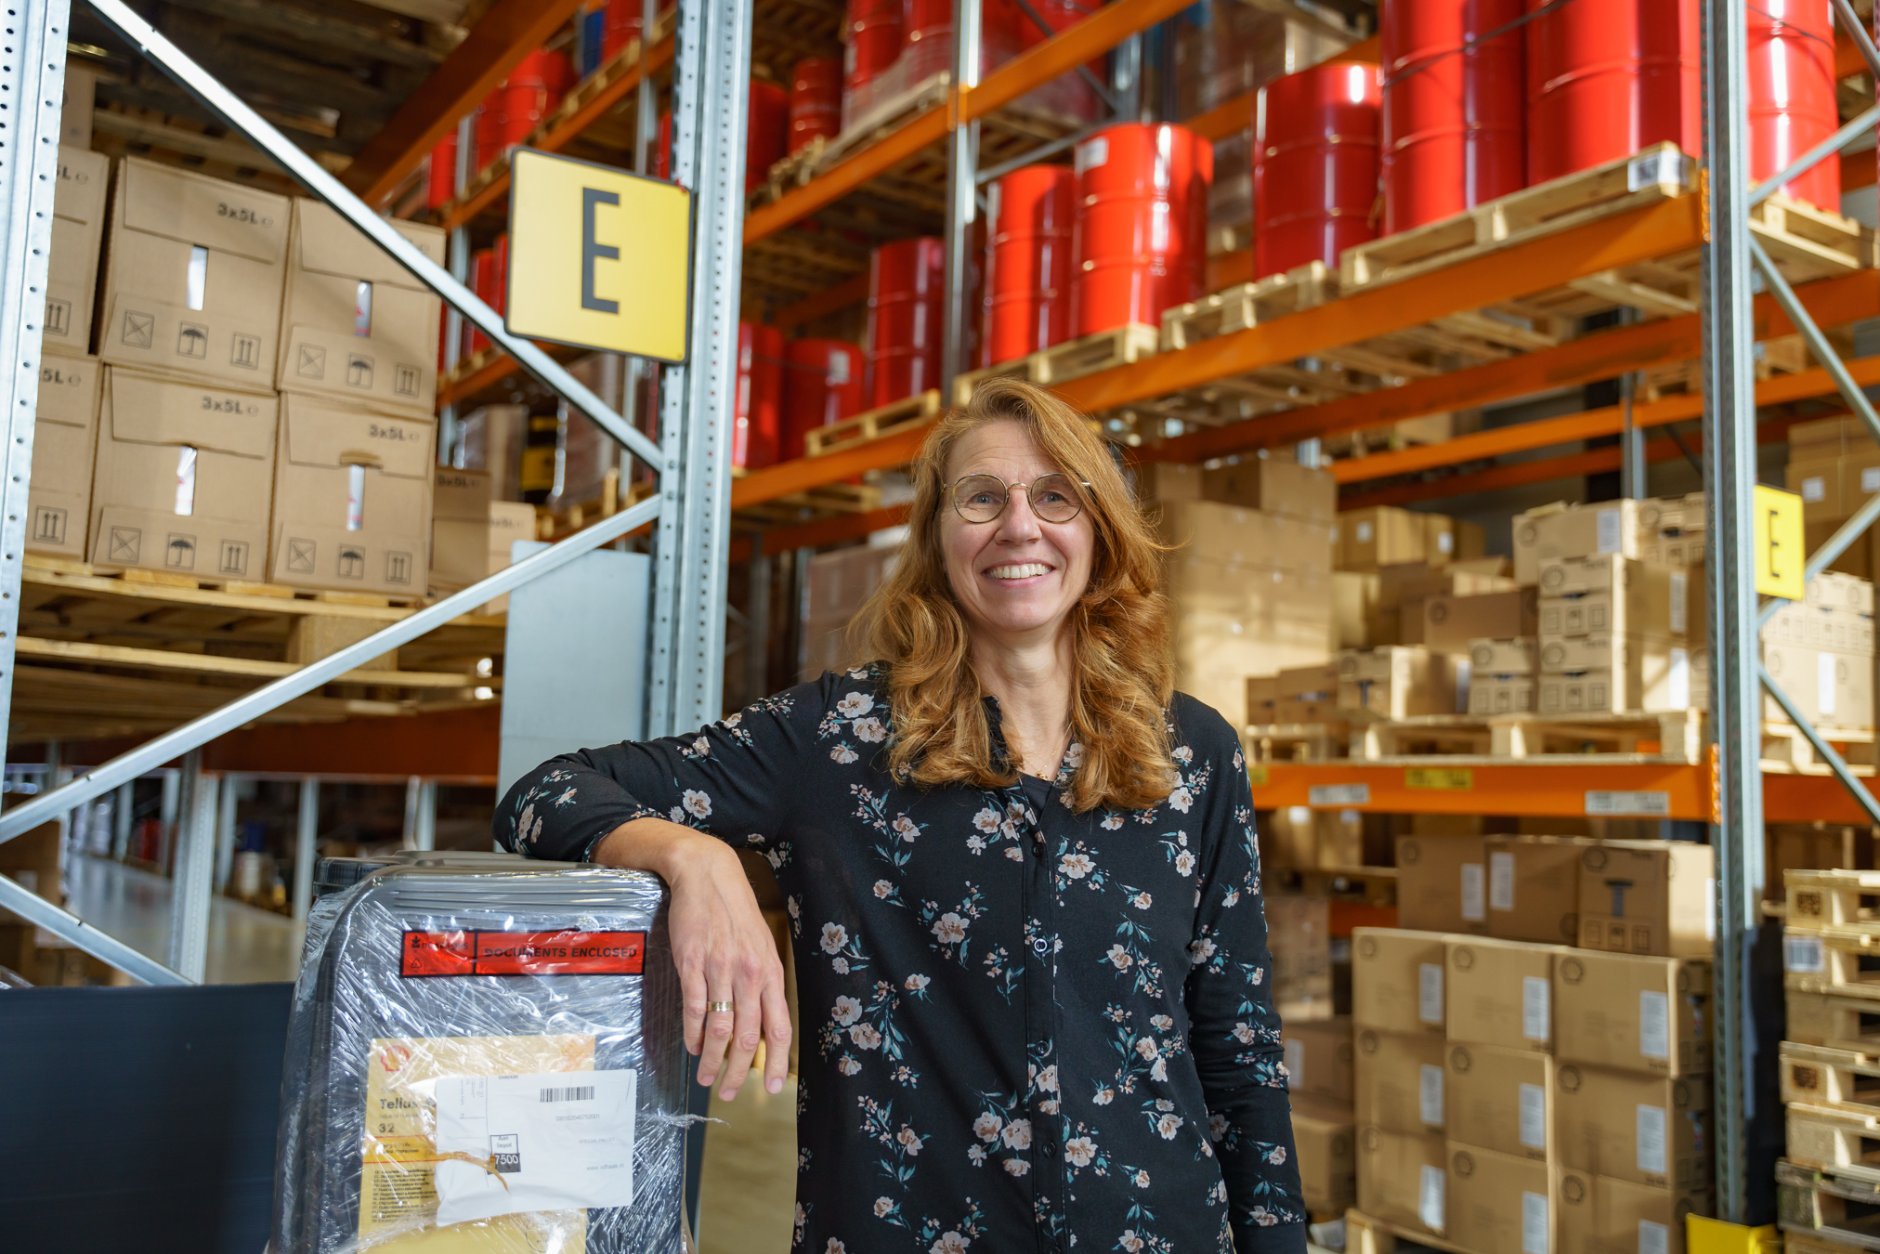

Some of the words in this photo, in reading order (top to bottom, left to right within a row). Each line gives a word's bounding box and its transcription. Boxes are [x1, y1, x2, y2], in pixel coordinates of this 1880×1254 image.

[217, 202, 258, 225] 3x5L
[581, 187, 620, 315] E
[201, 395, 243, 415] 3x5L
[368, 423, 406, 442] 3x5L
[1768, 509, 1780, 578] E
[483, 945, 567, 959] DOCUMENTS
[571, 945, 637, 958] ENCLOSED
[379, 1123, 395, 1133] 32
[495, 1154, 519, 1165] 7500
